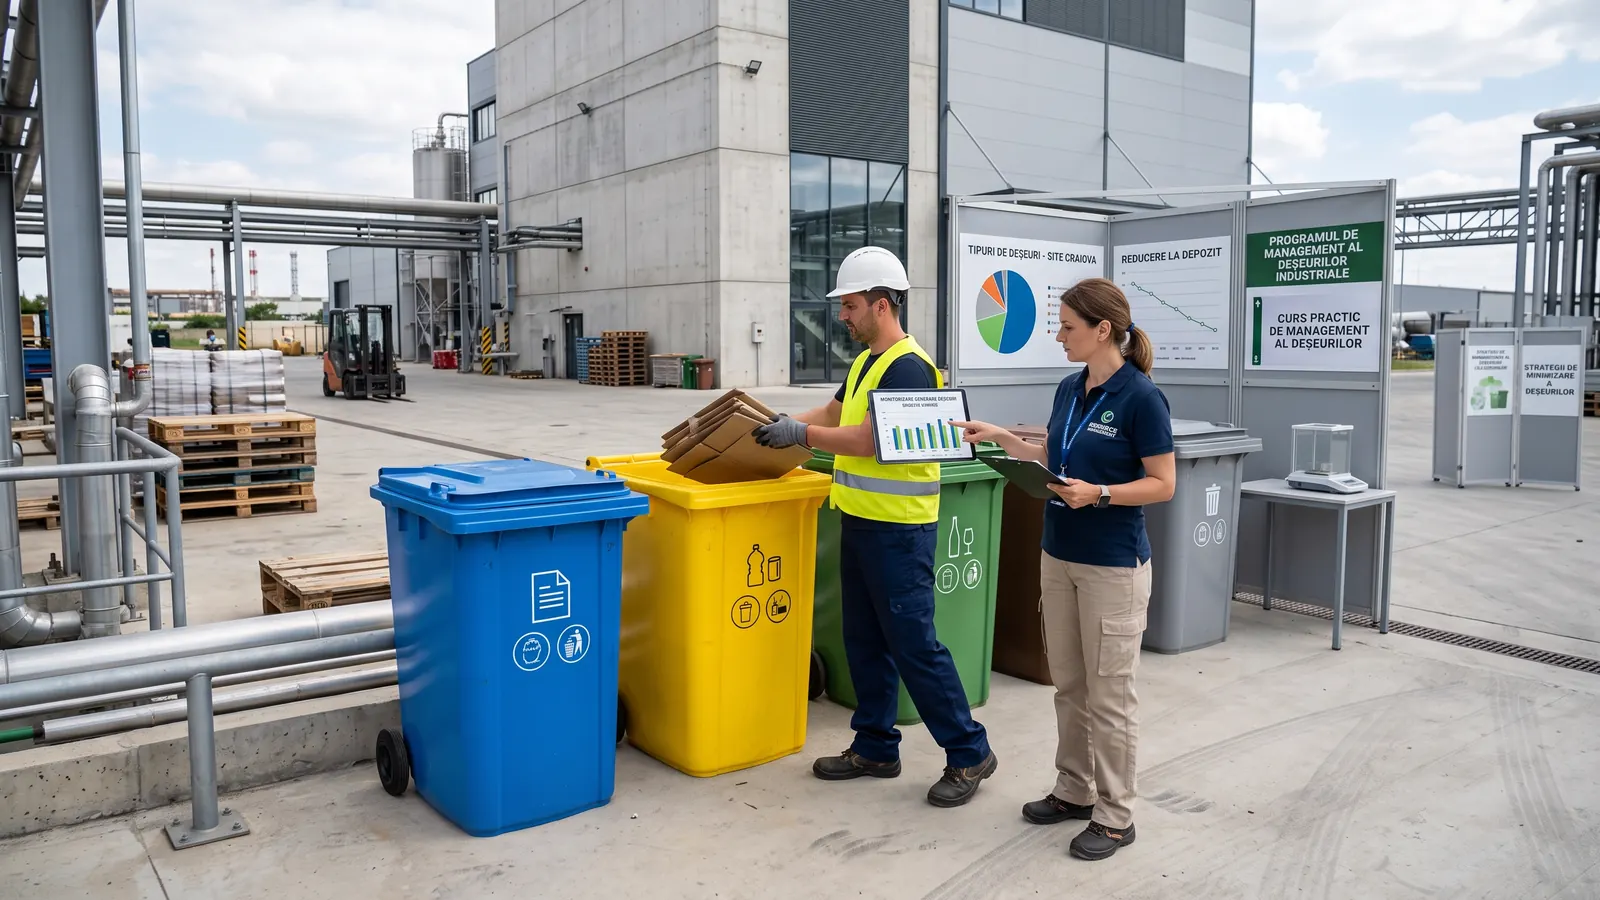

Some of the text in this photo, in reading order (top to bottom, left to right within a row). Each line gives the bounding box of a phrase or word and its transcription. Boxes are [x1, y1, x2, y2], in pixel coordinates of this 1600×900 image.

[1269, 229, 1359, 246] PROGRAMUL DE
[968, 244, 995, 256] TIPURI
[997, 247, 1008, 257] DE
[1047, 251, 1063, 262] SITE
[1065, 253, 1097, 264] CRAIOVA
[1121, 247, 1222, 264] REDUCERE LA DEPOZIT
[1264, 242, 1363, 259] MANAGEMENT AL
[1278, 255, 1348, 270] DEȘEURILOR
[1276, 268, 1350, 282] INDUSTRIALE
[1277, 312, 1361, 323] CURS PRACTIC
[1269, 325, 1370, 336] DE MANAGEMENT
[1274, 338, 1362, 351] AL DEȘEURILOR
